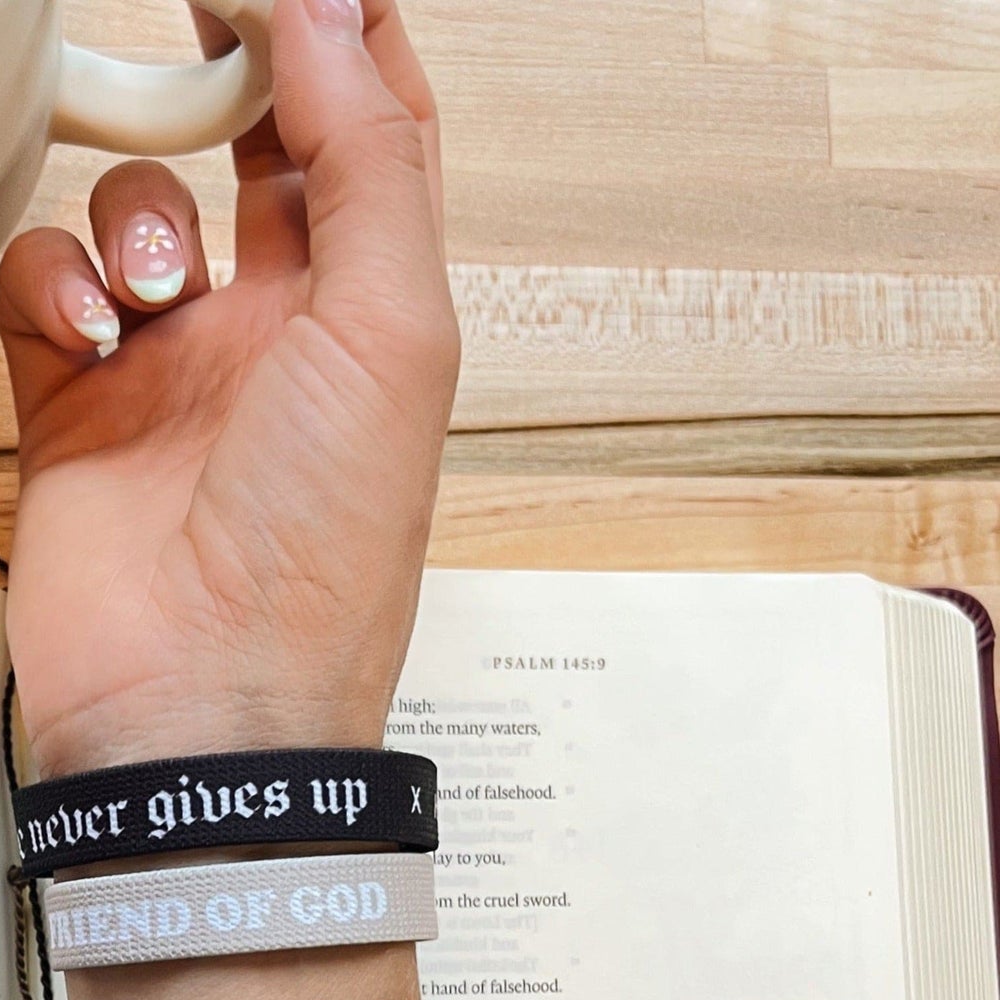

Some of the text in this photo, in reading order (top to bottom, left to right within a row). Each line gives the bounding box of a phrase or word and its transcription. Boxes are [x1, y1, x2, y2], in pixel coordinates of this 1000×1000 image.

[493, 657, 606, 670] PSALM 145:9
[398, 698, 436, 716] high;
[386, 721, 541, 737] rom the many waters,
[465, 785, 480, 800] of
[484, 785, 557, 800] falsehood.
[27, 800, 128, 853] never
[147, 775, 291, 839] gives
[311, 776, 369, 826] up
[457, 853, 471, 865] to
[475, 854, 506, 867] you,
[205, 885, 278, 933] OF
[289, 881, 388, 927] GOD
[458, 893, 481, 908] the
[484, 893, 519, 908] cruel
[523, 892, 571, 908] sword.
[431, 980, 467, 995] hand
[471, 980, 487, 995] of
[490, 978, 563, 994] falsehood.
